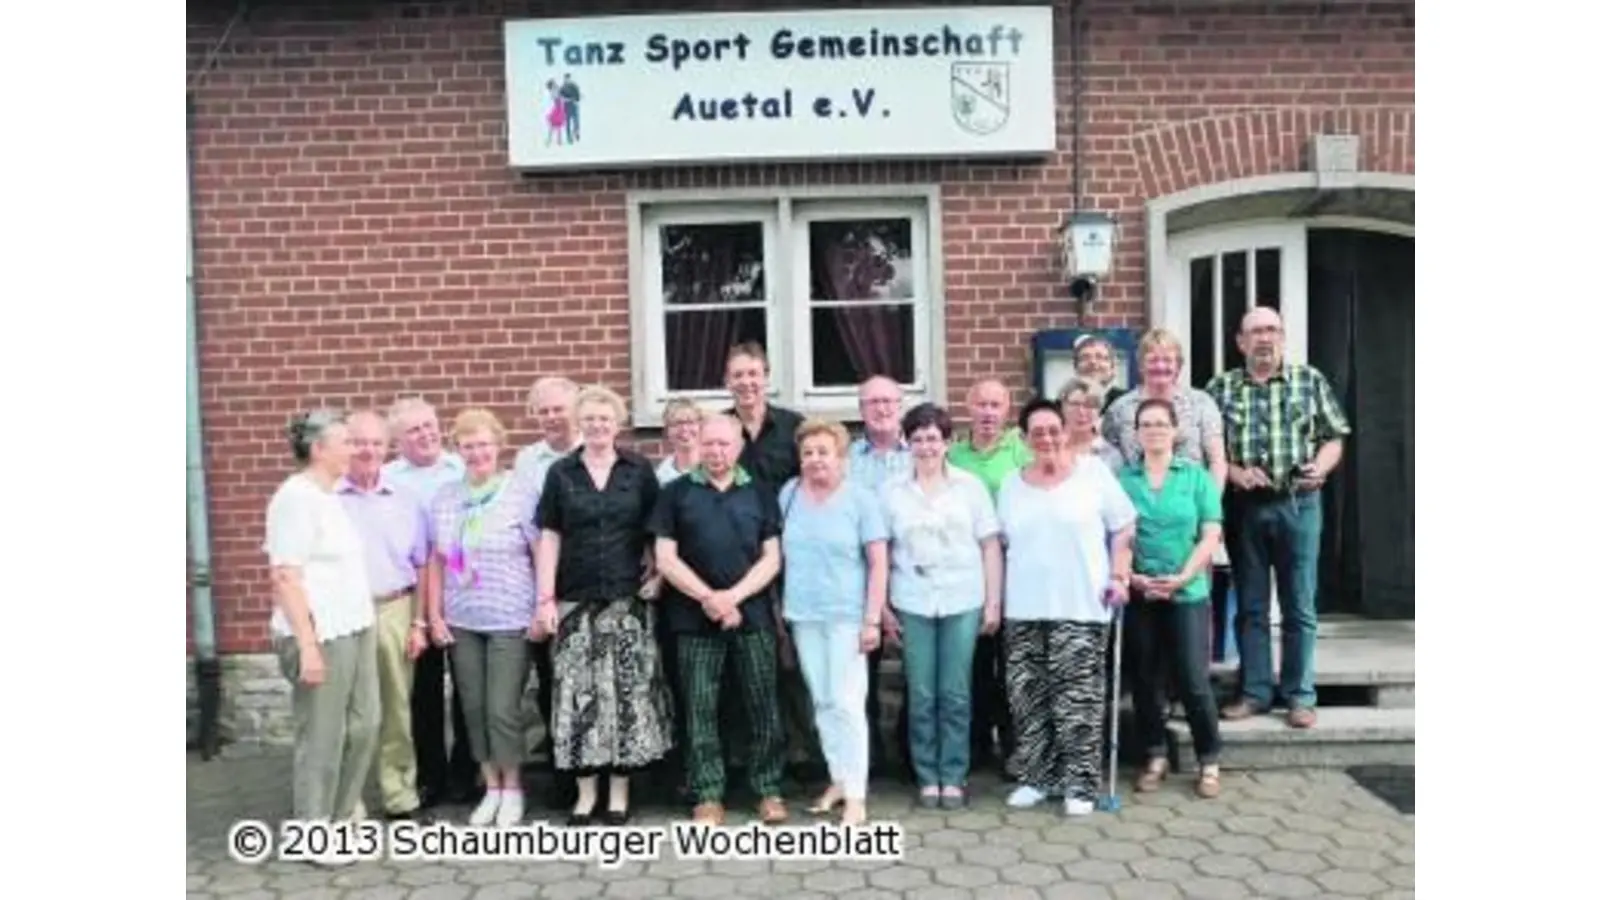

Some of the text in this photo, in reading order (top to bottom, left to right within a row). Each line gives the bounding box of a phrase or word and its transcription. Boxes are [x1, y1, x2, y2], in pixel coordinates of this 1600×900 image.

[537, 25, 1024, 69] Tanz Sport Gemeinschaft
[672, 88, 892, 121] Auetal e.V.
